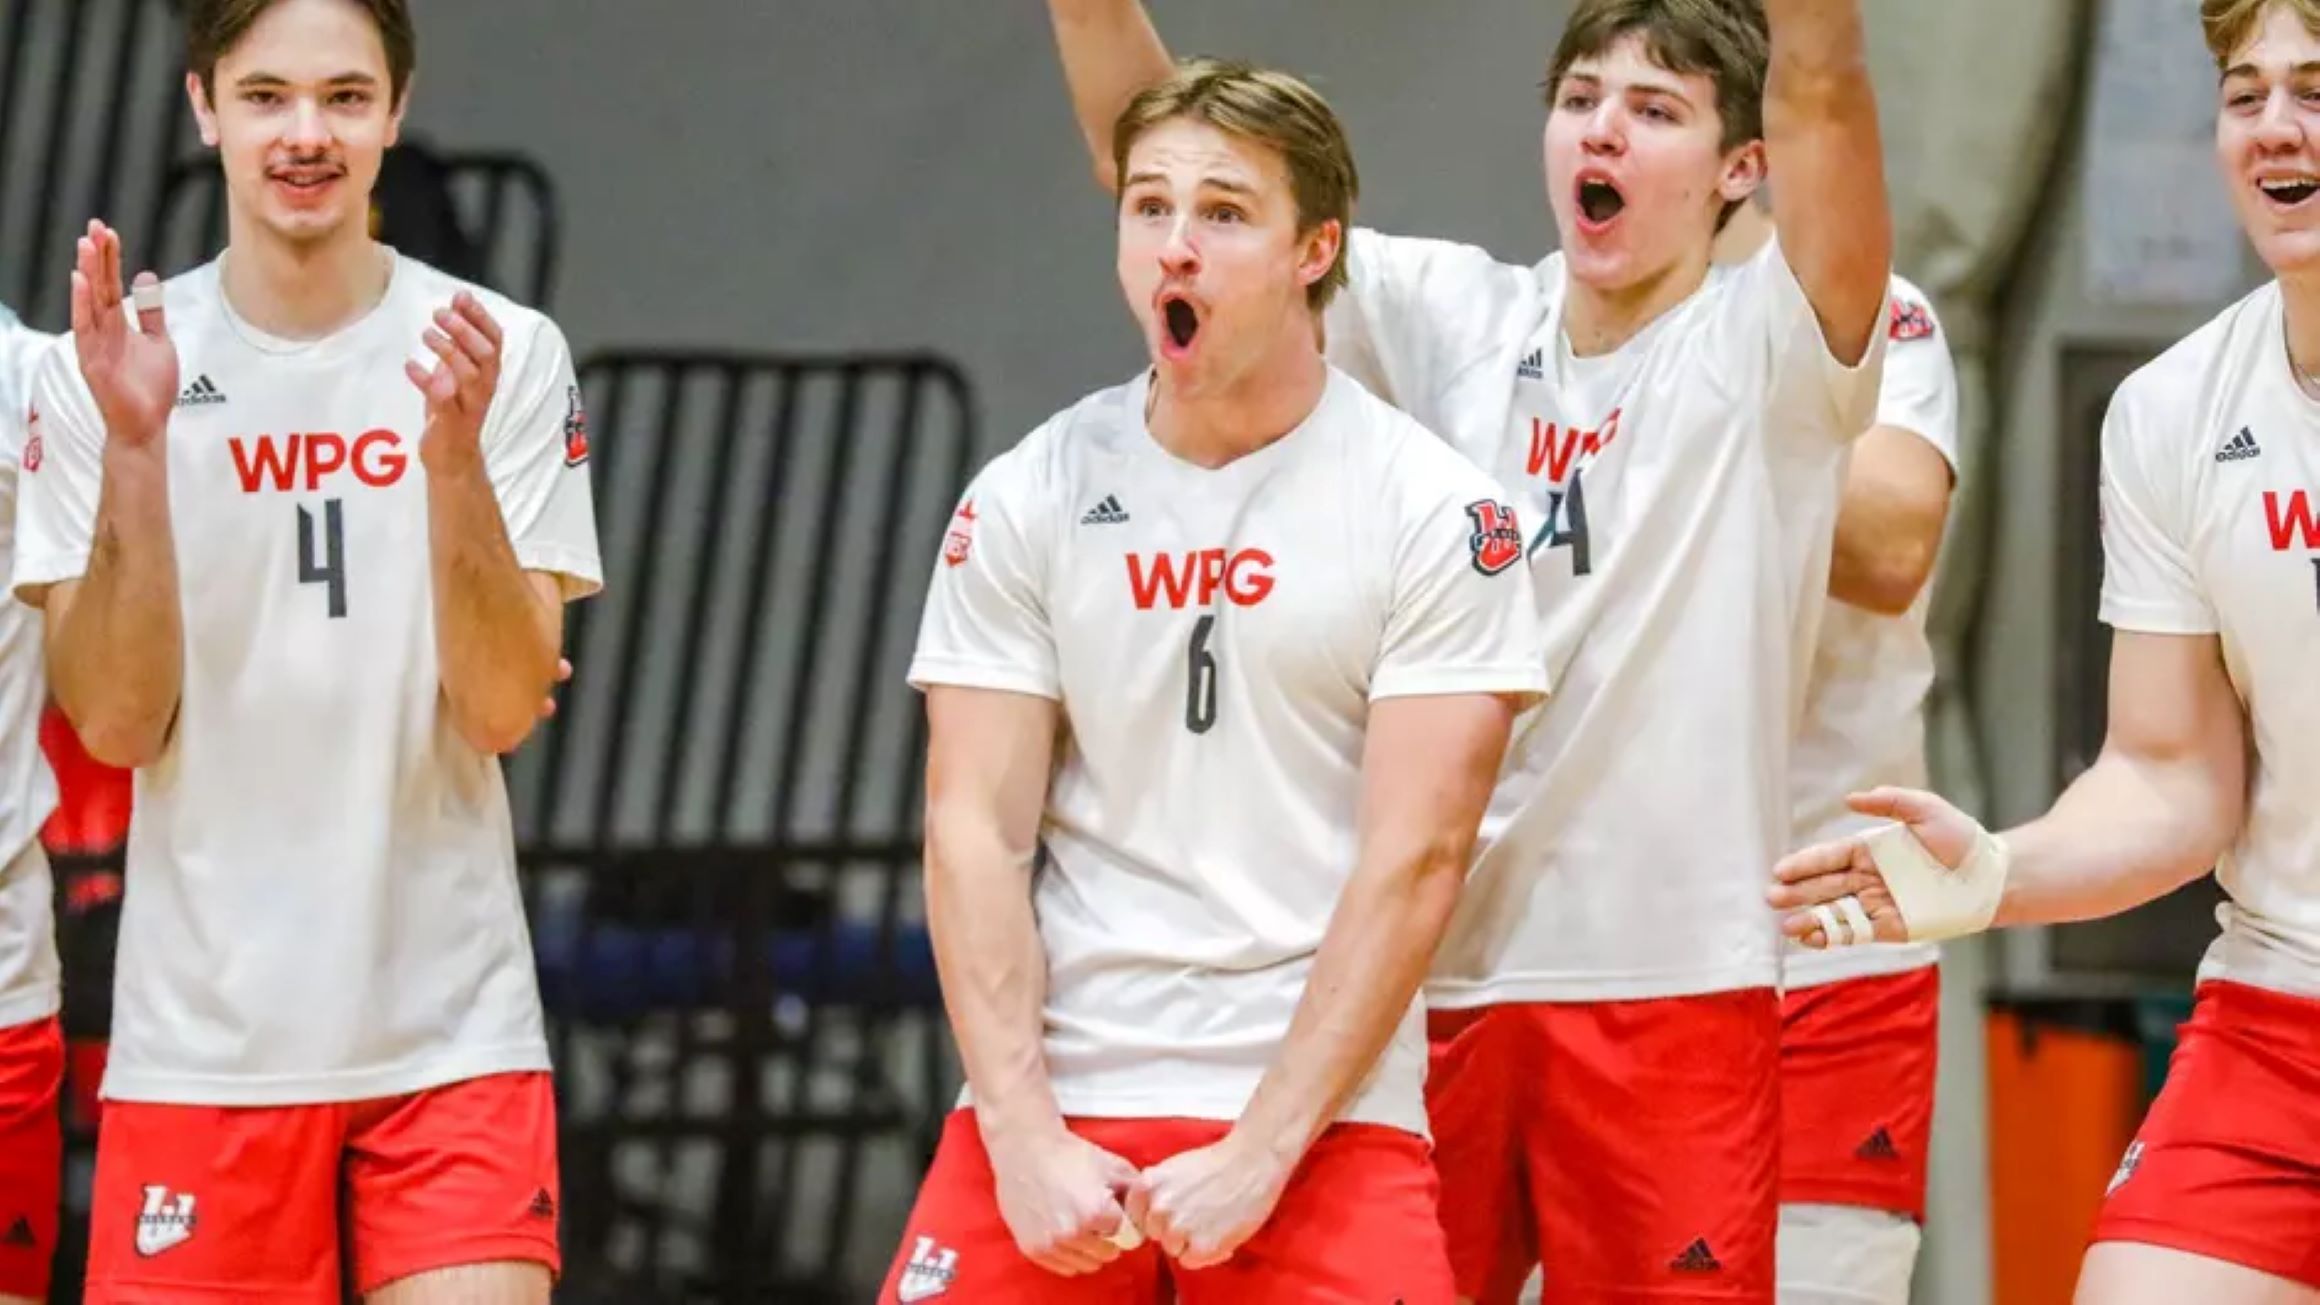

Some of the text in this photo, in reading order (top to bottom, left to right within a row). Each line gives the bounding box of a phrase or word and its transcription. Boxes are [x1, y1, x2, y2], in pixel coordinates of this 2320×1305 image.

[229, 429, 408, 493] WPG
[297, 498, 347, 617] 4
[1127, 548, 1275, 610] WPG
[1186, 615, 1217, 734] 6
